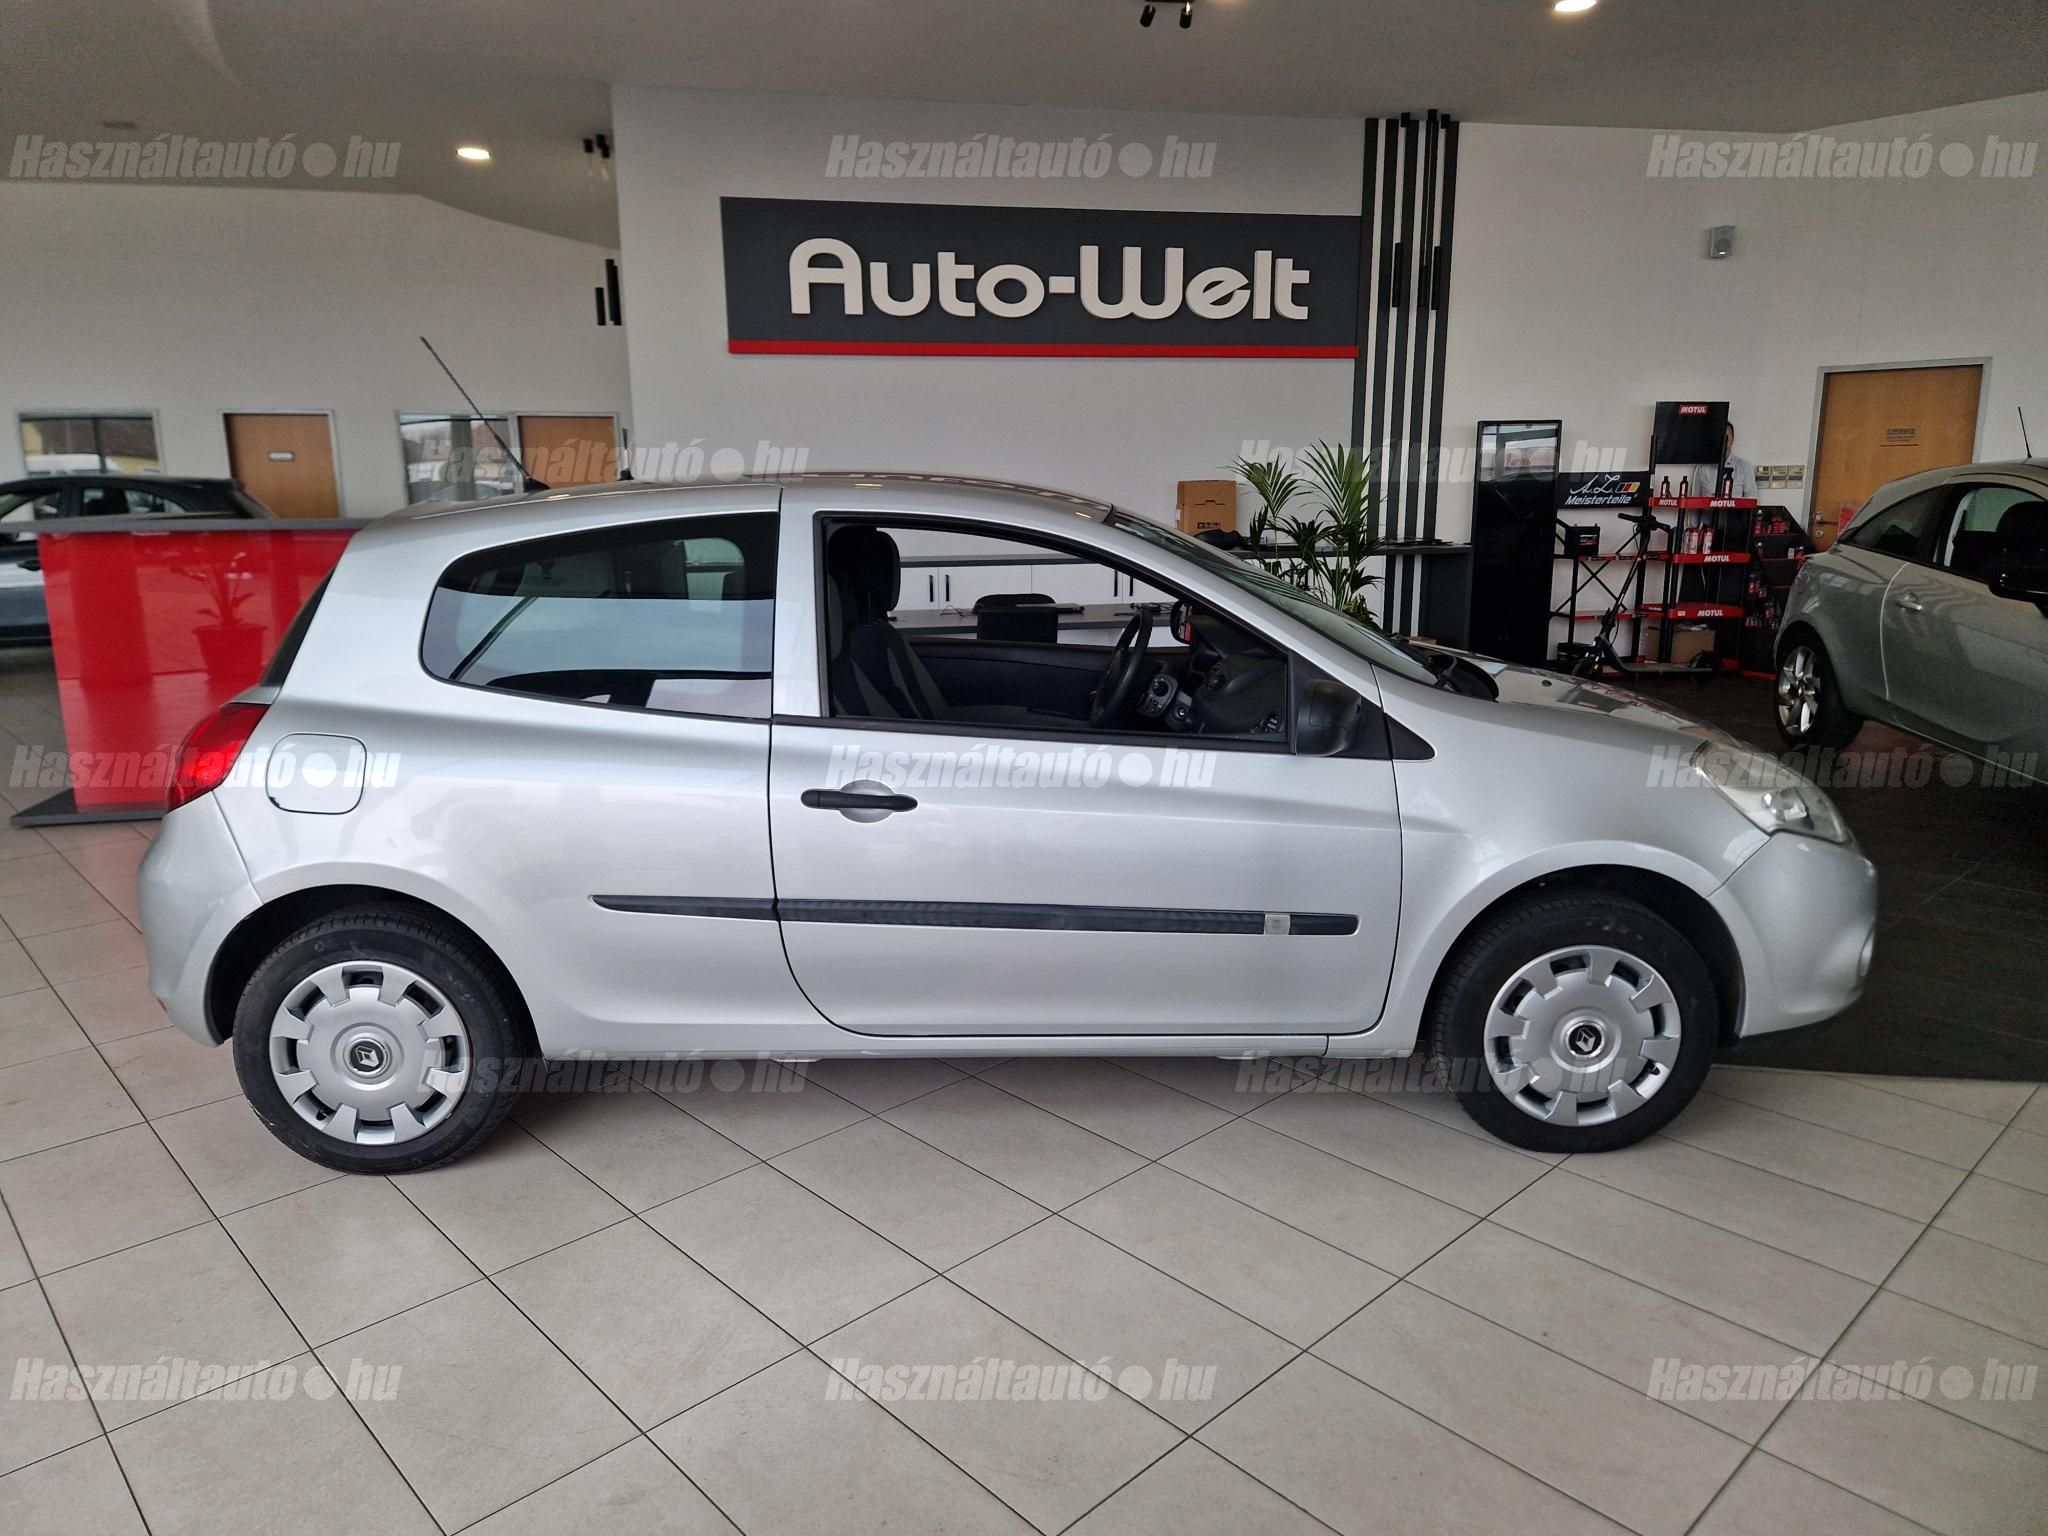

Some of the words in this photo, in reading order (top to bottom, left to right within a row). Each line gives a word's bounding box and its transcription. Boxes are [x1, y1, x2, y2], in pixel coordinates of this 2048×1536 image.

[789, 238, 1310, 320] Auto-Welt
[1680, 405, 1707, 414] MOTUL
[1565, 494, 1632, 505] Meisterteile
[1697, 609, 1723, 617] MOTUL
